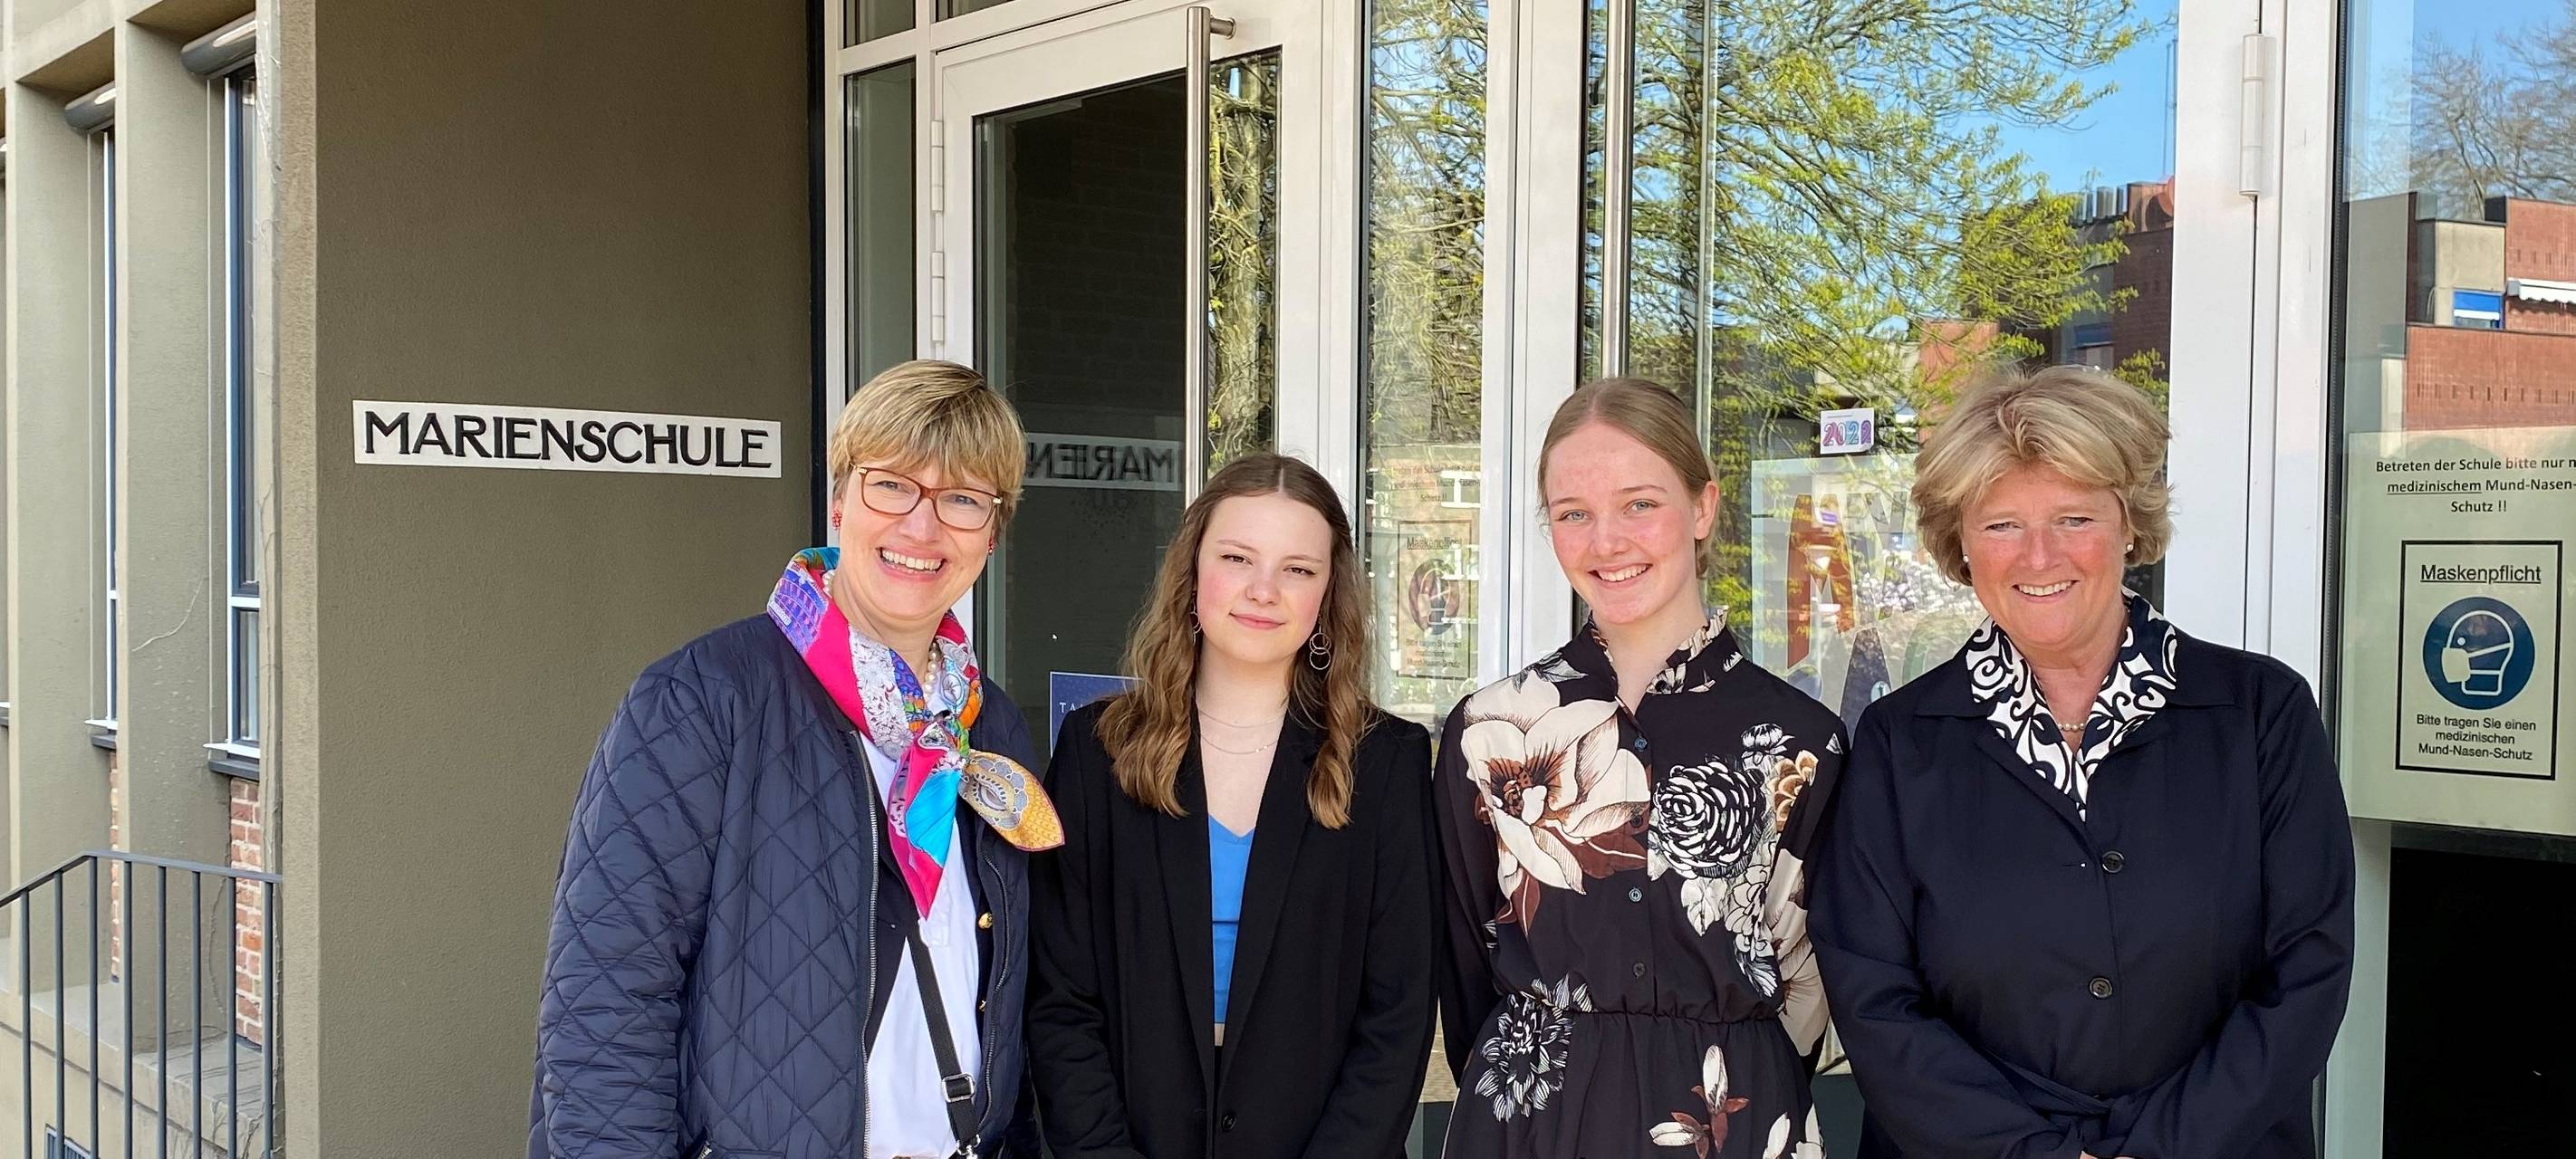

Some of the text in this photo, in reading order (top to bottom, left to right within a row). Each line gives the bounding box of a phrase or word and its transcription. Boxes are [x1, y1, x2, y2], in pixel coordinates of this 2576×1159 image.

[365, 410, 772, 468] MARIENSCHULE
[2377, 461, 2430, 472] Betreten
[2434, 459, 2456, 471] der
[2459, 458, 2501, 471] Schule
[2506, 458, 2537, 469] bitte
[2542, 459, 2564, 469] nur
[2387, 479, 2576, 494] medizinischem Mund-Nasen-
[2451, 500, 2507, 512] Schutz !!
[2421, 564, 2542, 584] Maskenpflicht
[2417, 714, 2536, 731] Bitte tragen Sie einen
[2436, 731, 2515, 744] medizinischen
[2418, 742, 2533, 761] Mund-Nasen-Schutz
